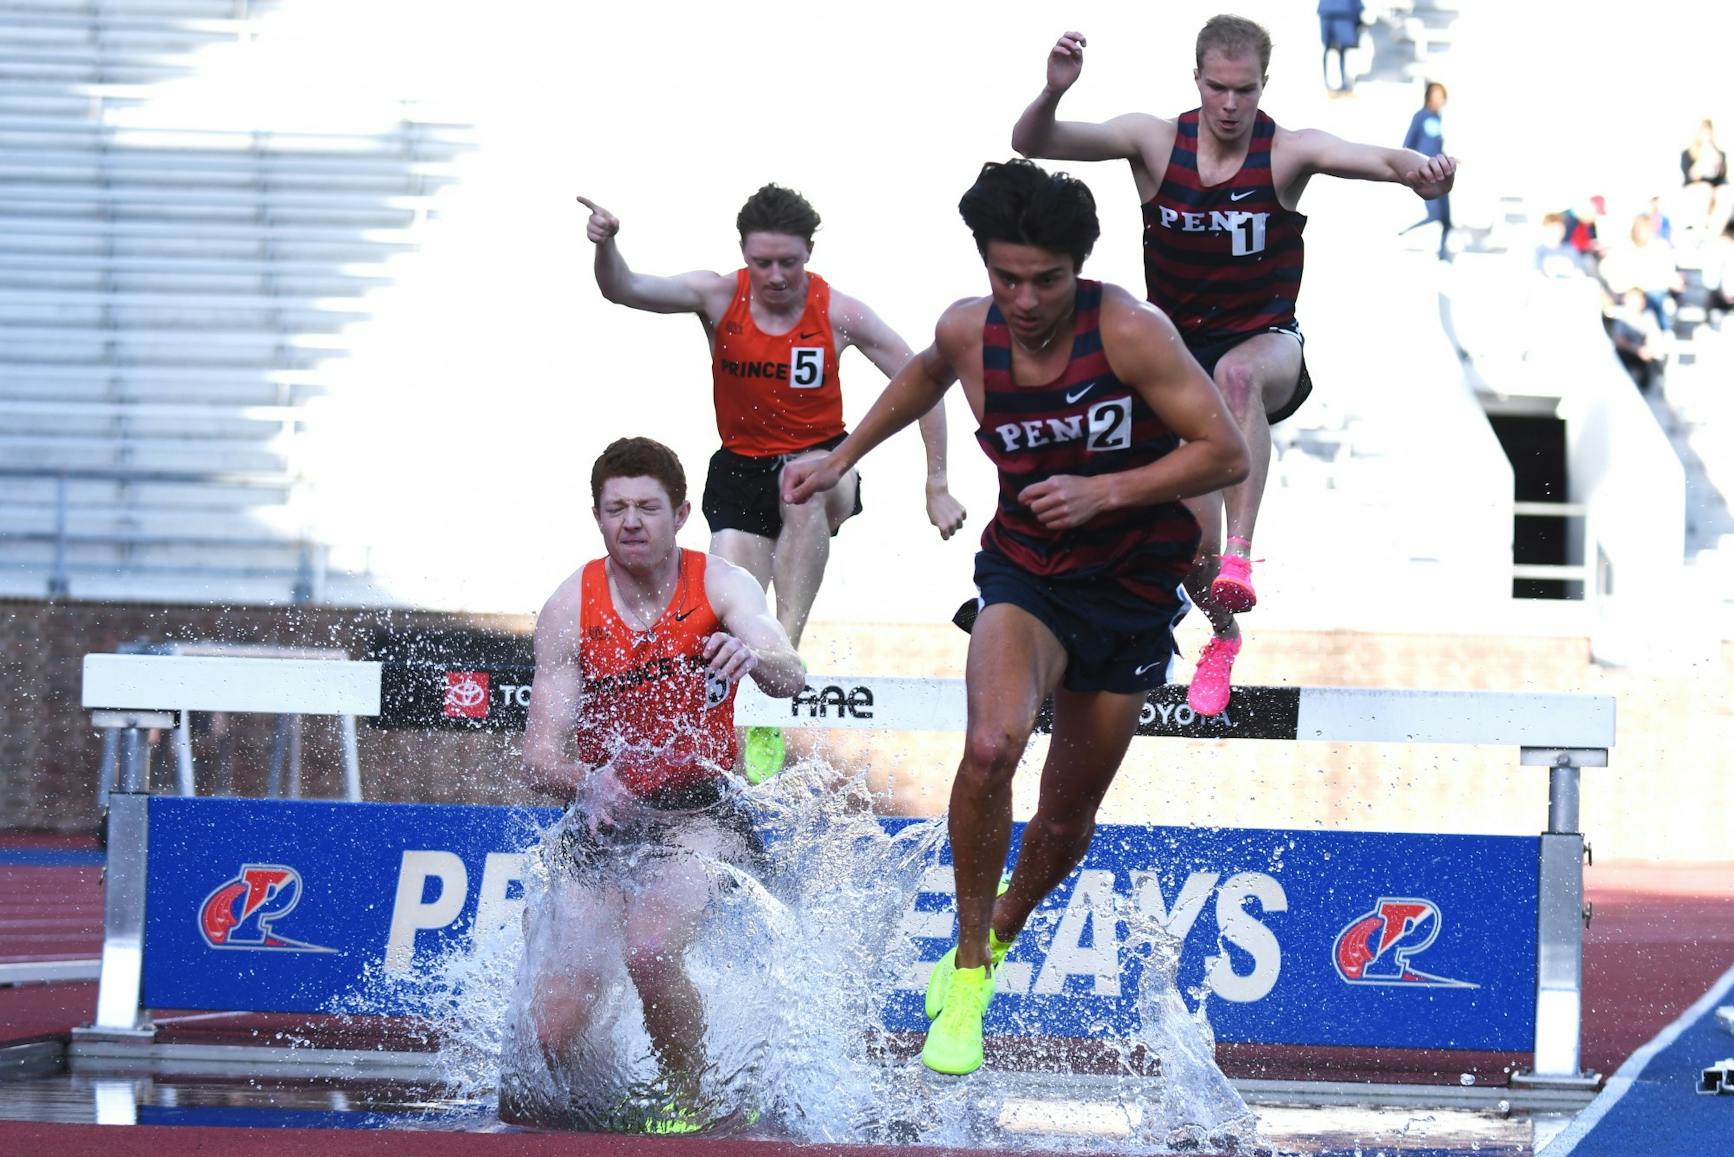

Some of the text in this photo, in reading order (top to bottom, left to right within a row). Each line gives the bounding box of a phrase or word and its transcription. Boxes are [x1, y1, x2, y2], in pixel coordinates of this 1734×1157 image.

[1159, 206, 1270, 232] PEN
[1237, 217, 1254, 251] 1
[721, 360, 796, 382] PRINCE
[795, 351, 817, 385] 5
[996, 414, 1088, 452] PEN
[1094, 405, 1124, 448] 2
